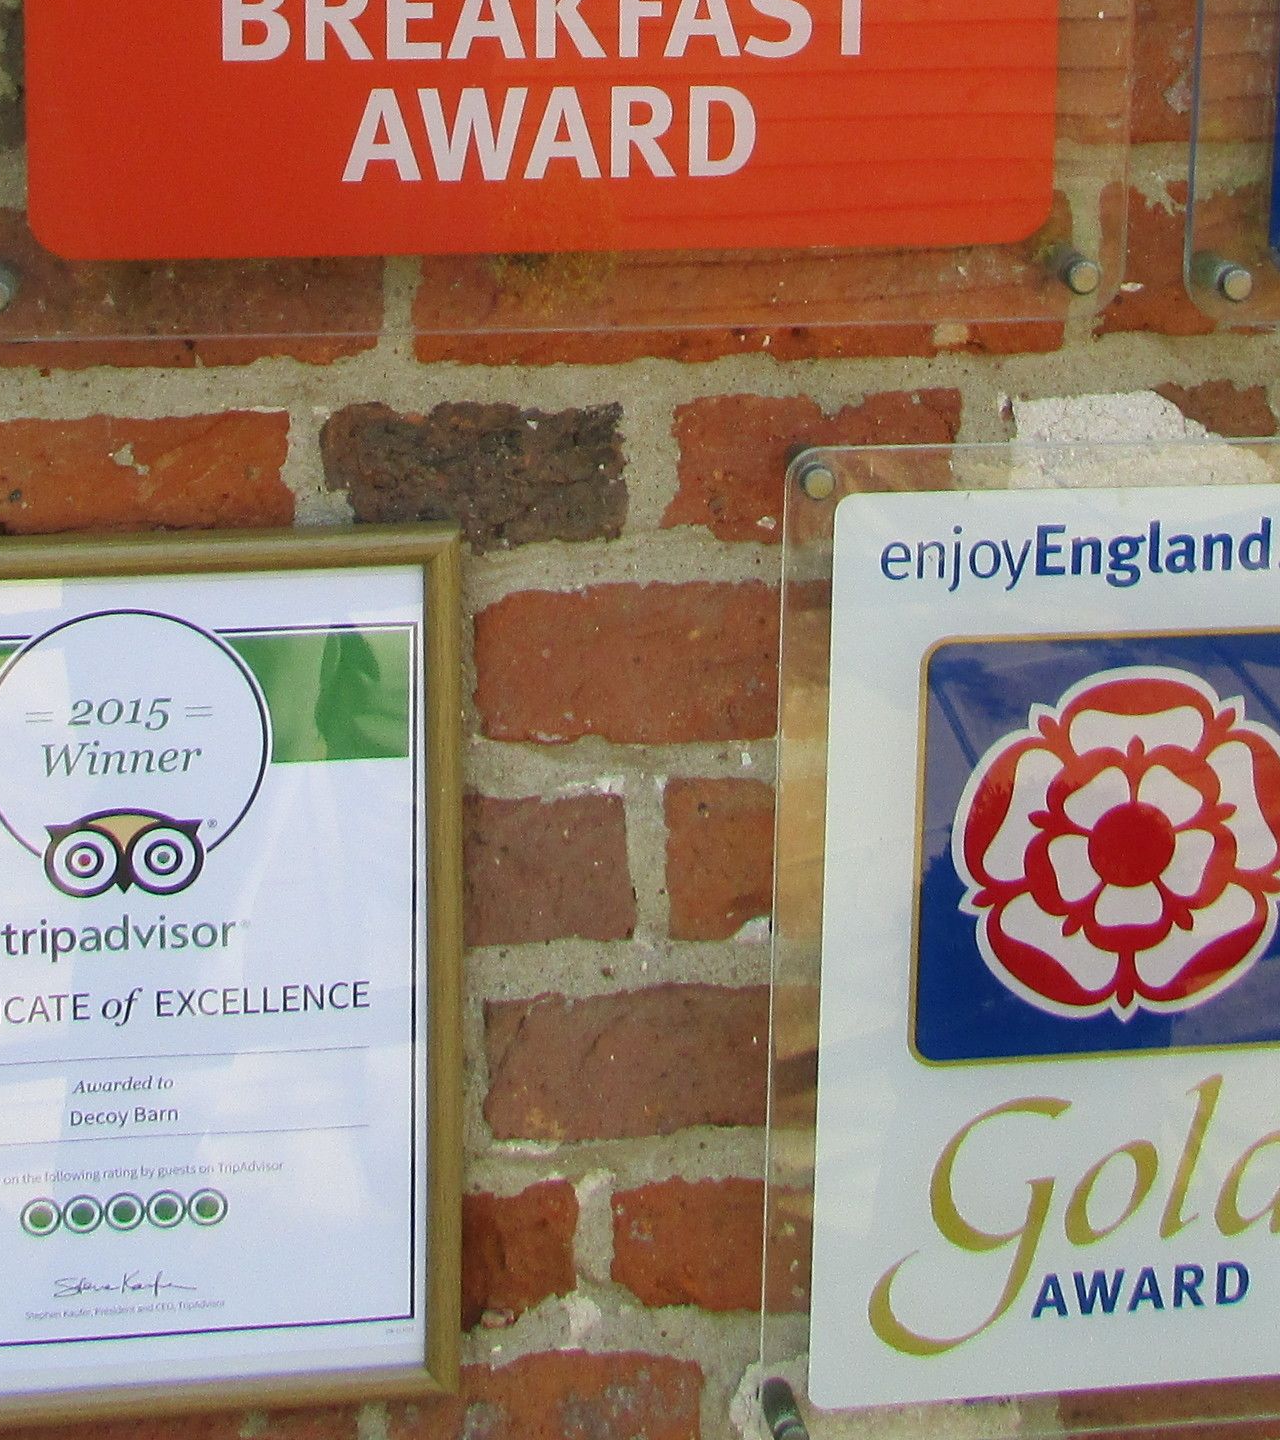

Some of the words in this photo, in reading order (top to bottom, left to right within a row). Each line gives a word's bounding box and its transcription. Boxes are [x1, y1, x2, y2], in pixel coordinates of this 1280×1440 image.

[341, 86, 757, 182] AWARD
[67, 695, 172, 731] 2015
[40, 740, 203, 778] Winner
[0, 915, 237, 963] tripadvisor
[101, 986, 144, 1027] of
[155, 980, 371, 1018] EXCELLENCE
[72, 1074, 153, 1094] Awarded
[157, 1075, 174, 1090] to
[70, 1109, 129, 1128] Decoy
[134, 1106, 179, 1123] Barn
[1030, 1260, 1251, 1320] AWARD
